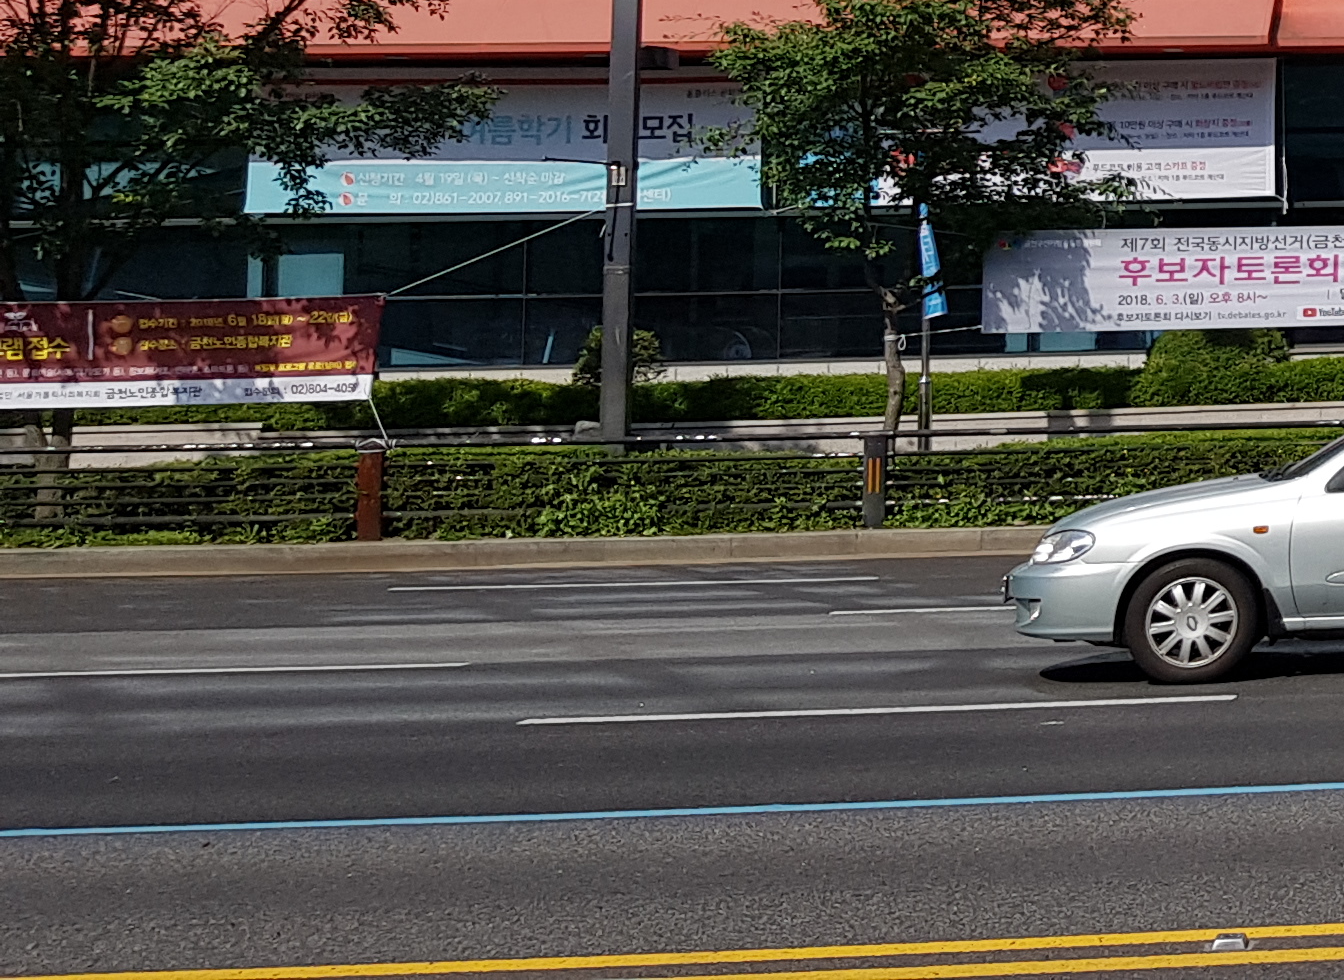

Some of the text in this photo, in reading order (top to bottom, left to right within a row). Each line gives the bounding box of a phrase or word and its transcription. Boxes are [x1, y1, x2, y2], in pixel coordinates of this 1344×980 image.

[582, 114, 608, 145] 회
[638, 113, 694, 146] 모집
[440, 171, 465, 186] 19일
[541, 171, 566, 185] 마감
[1121, 235, 1167, 252] 제7회
[1119, 254, 1340, 287] 후보자토론회
[1118, 294, 1151, 306] 2018.
[1208, 292, 1232, 304] 오후
[1175, 311, 1212, 321] 다시보기
[27, 337, 71, 361] 접수
